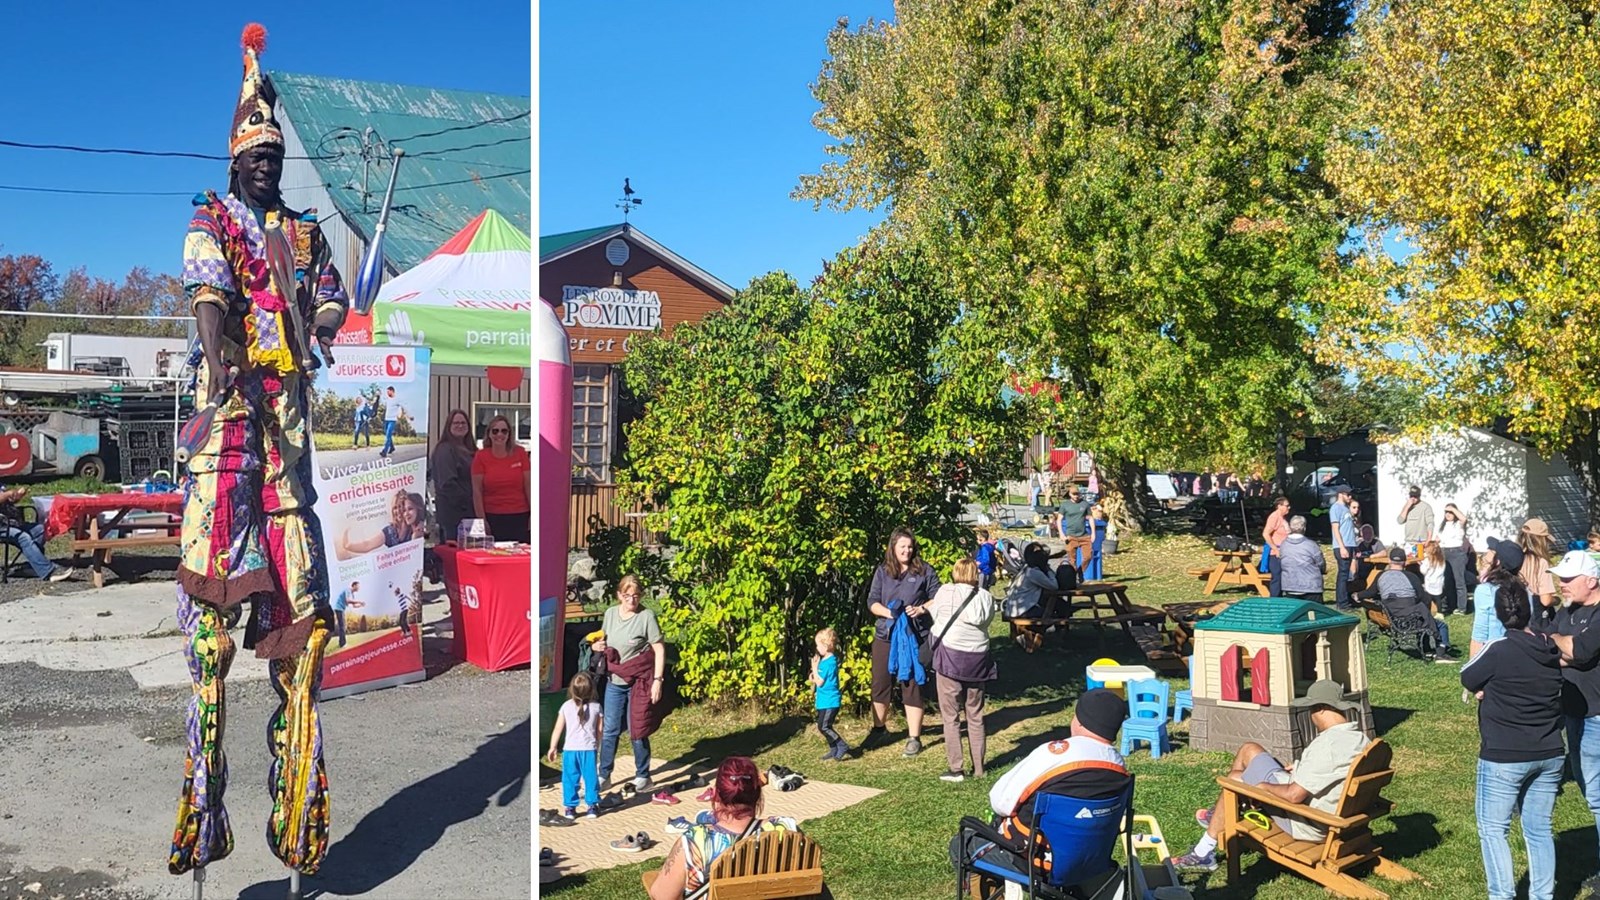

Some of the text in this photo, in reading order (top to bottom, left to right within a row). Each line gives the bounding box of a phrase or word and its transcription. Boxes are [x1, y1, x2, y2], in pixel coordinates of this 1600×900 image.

[565, 287, 660, 305] LES ROY DE LA
[565, 301, 660, 327] POMME
[595, 337, 615, 352] et
[336, 364, 385, 376] JEUNESSE
[325, 457, 392, 479] Vivez une
[329, 475, 415, 504] enrichissante
[330, 636, 413, 675] parrainagejeunesse.com
